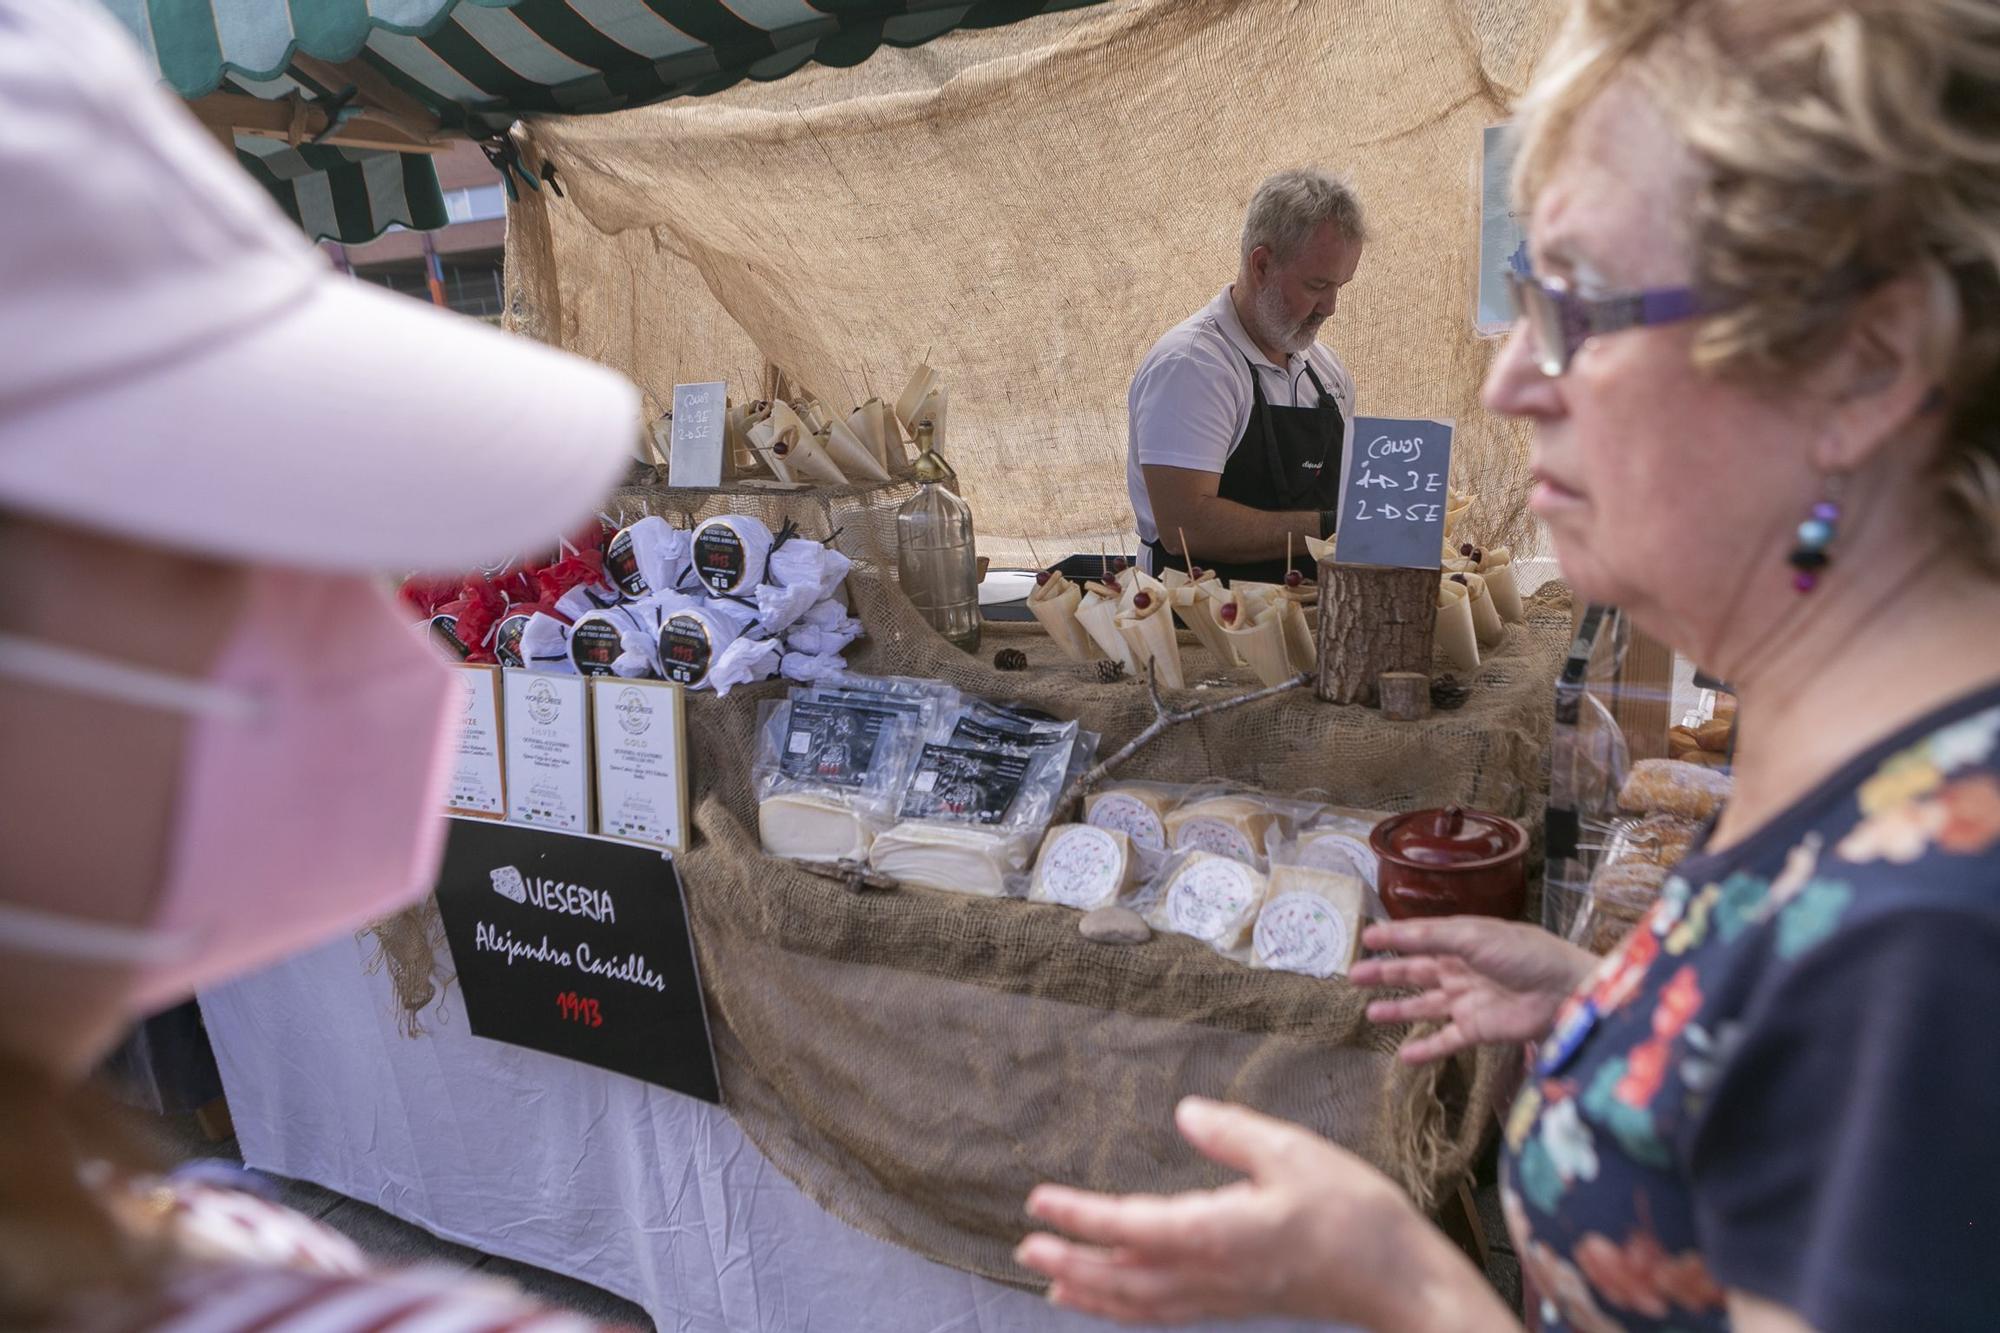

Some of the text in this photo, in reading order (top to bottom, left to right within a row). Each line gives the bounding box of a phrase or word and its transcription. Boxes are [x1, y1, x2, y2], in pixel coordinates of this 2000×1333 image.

[1355, 500, 1373, 521] 2
[624, 738, 648, 749] GOLD
[476, 920, 666, 992] Alejandro Casielles
[556, 991, 603, 1028] 1913
